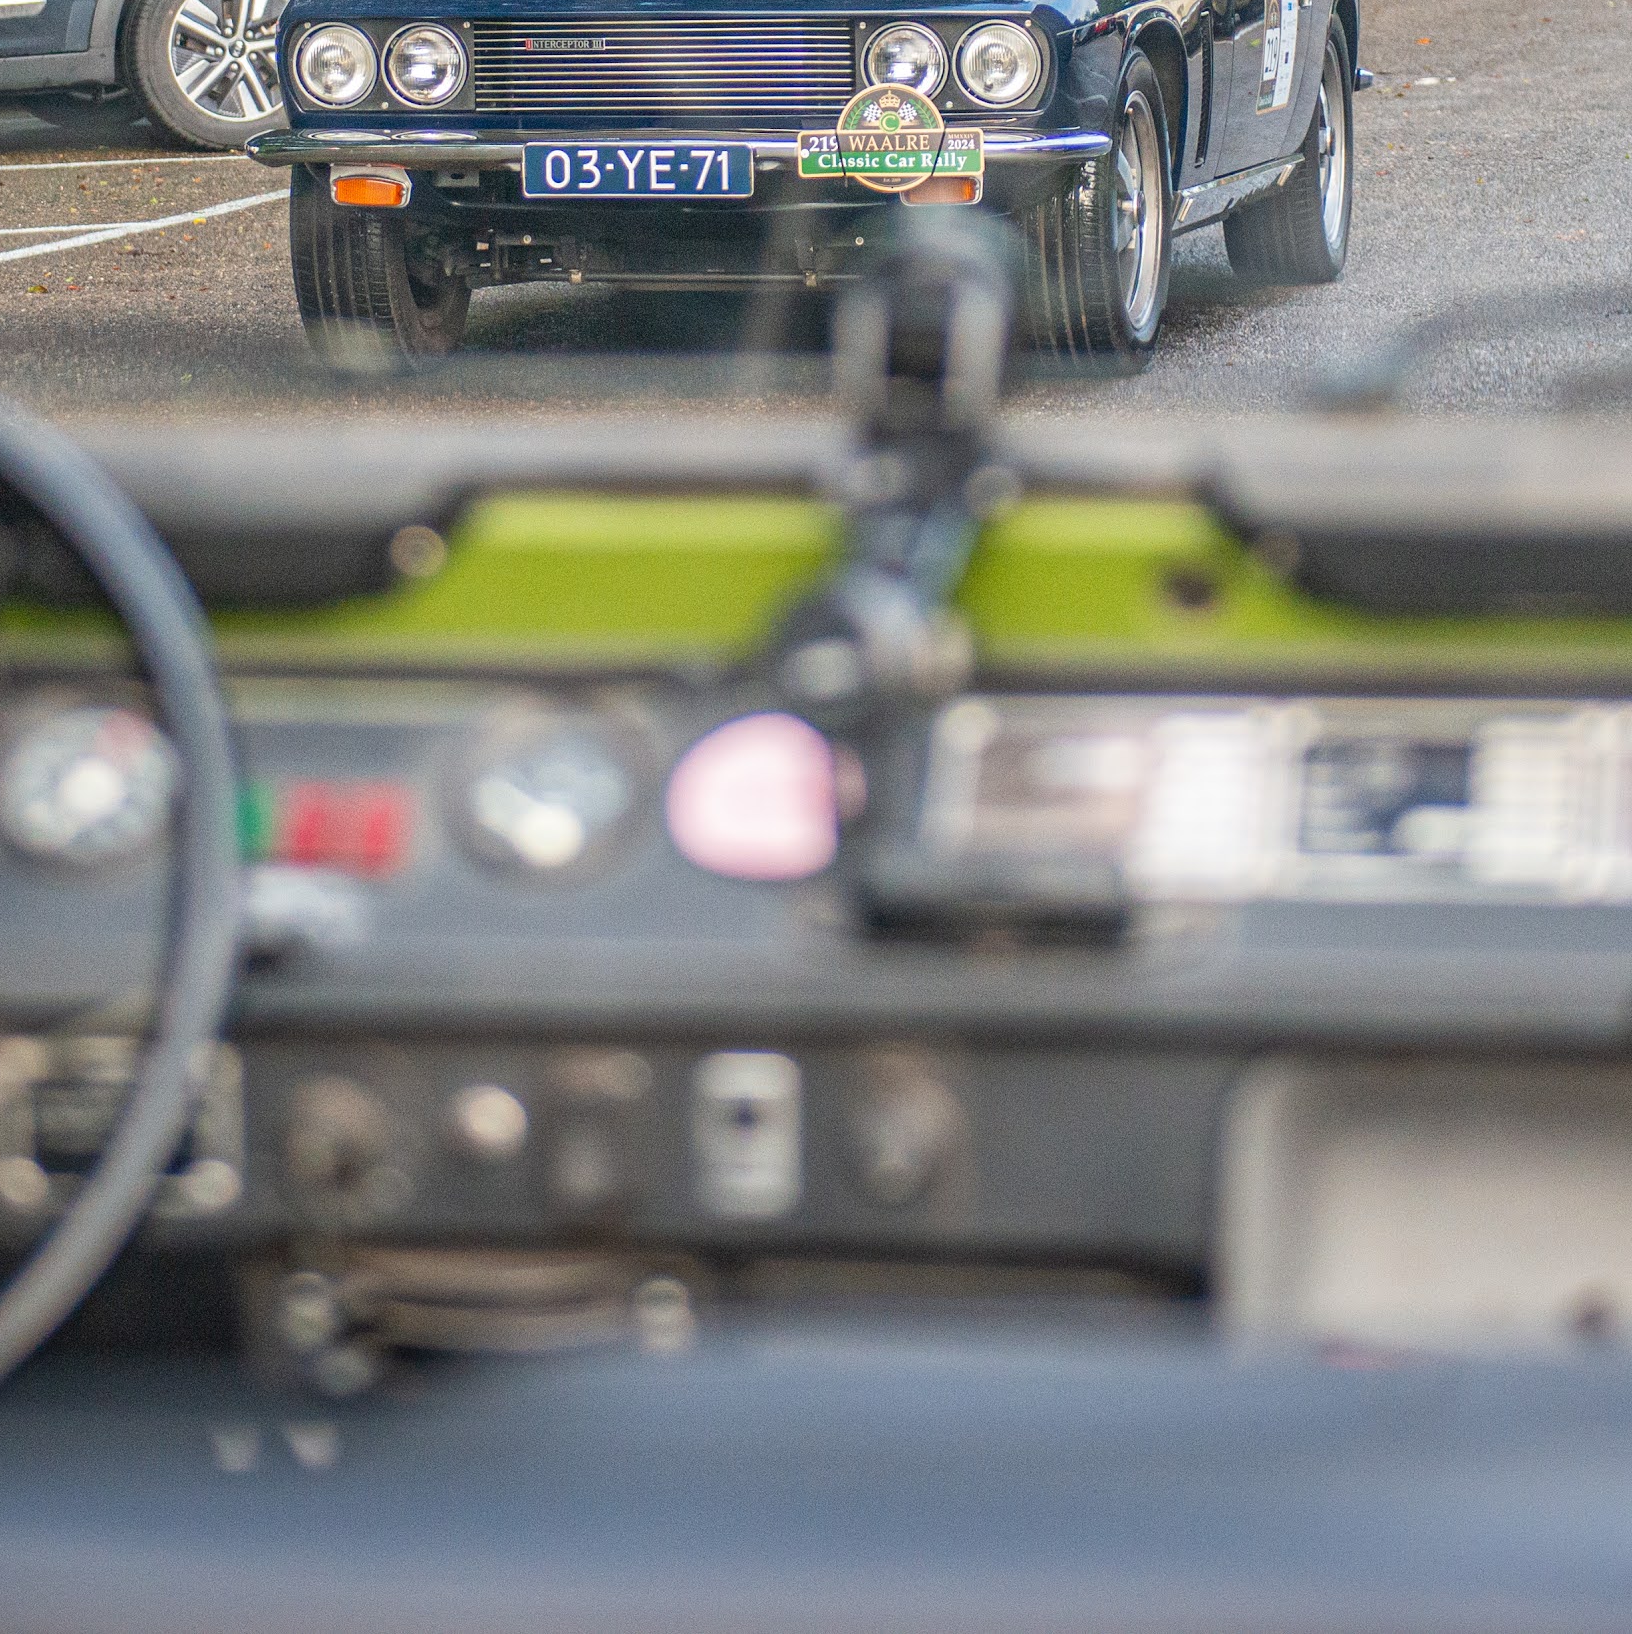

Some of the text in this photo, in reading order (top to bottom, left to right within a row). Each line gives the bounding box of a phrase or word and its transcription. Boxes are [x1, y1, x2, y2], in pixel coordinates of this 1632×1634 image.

[527, 39, 590, 50] INTERCEPTOR
[809, 135, 839, 152] 219
[849, 134, 930, 152] WAALRE
[947, 139, 975, 150] 2024
[818, 152, 968, 170] Classic Car Rally
[544, 149, 729, 191] 03-YE-71
